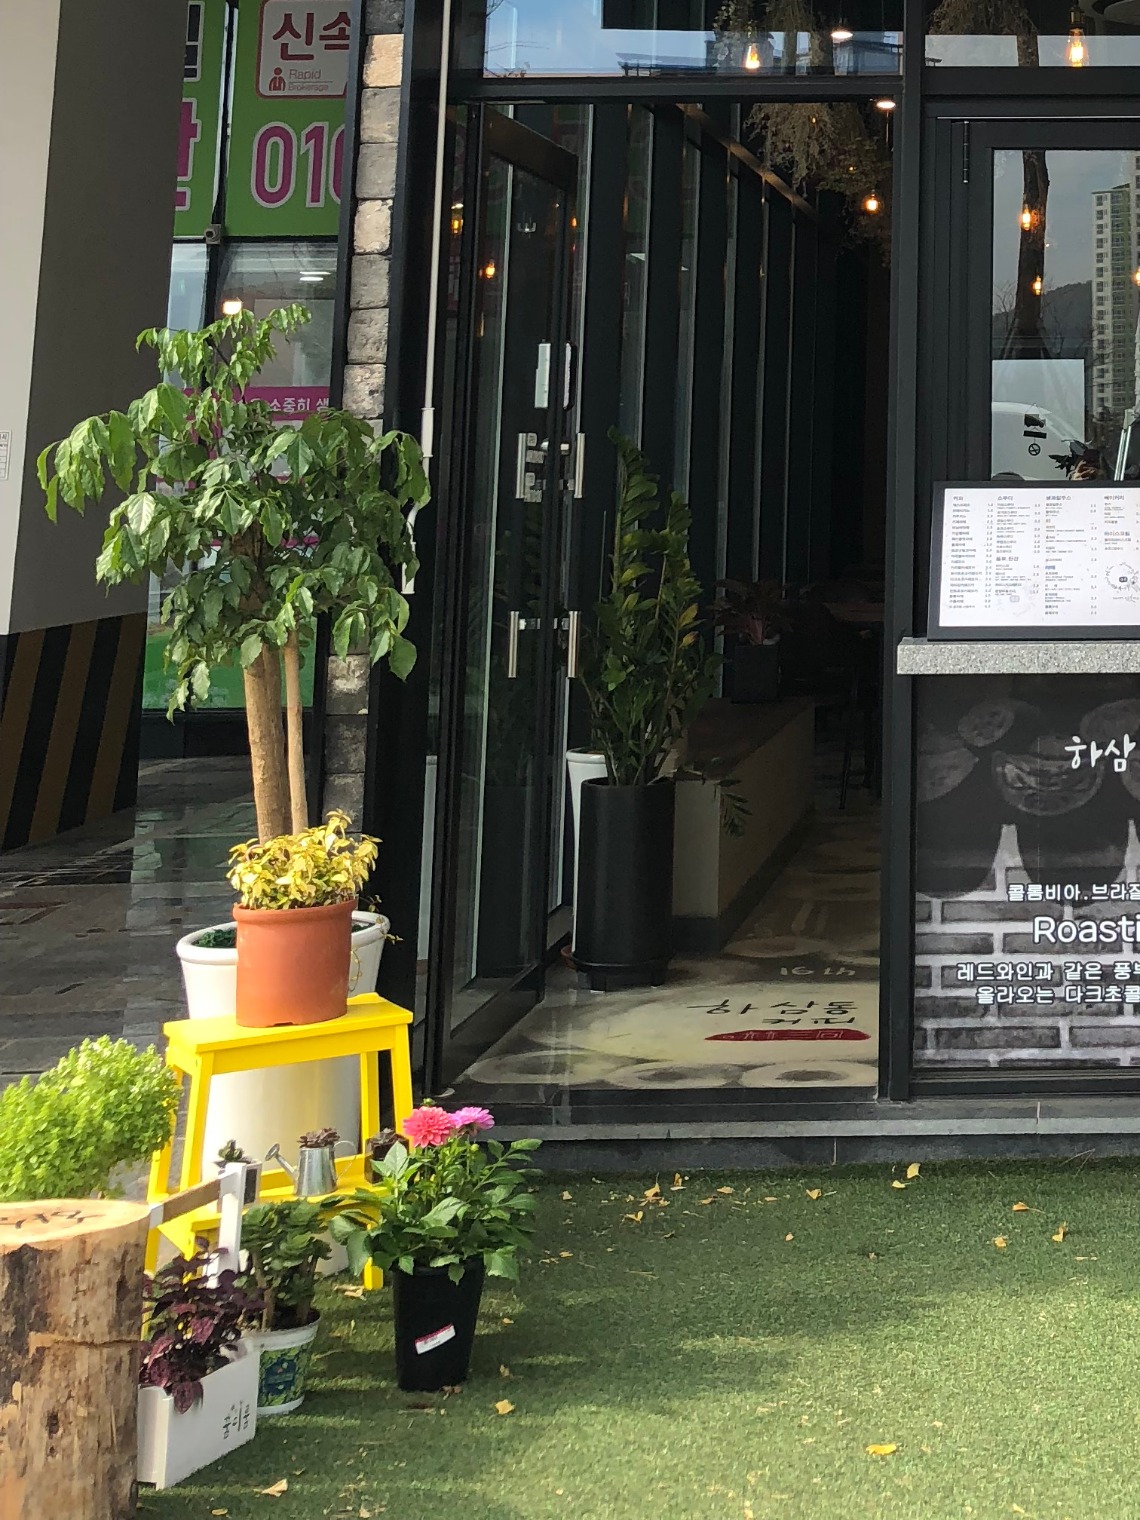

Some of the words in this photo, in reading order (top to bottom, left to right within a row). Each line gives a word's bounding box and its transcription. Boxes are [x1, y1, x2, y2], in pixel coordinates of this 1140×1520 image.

[289, 68, 321, 80] Rapid
[957, 962, 1053, 981] 레드와인과
[1064, 962, 1102, 980] 같은
[976, 986, 1054, 1005] 올라오는
[687, 999, 858, 1015] 하삼동
